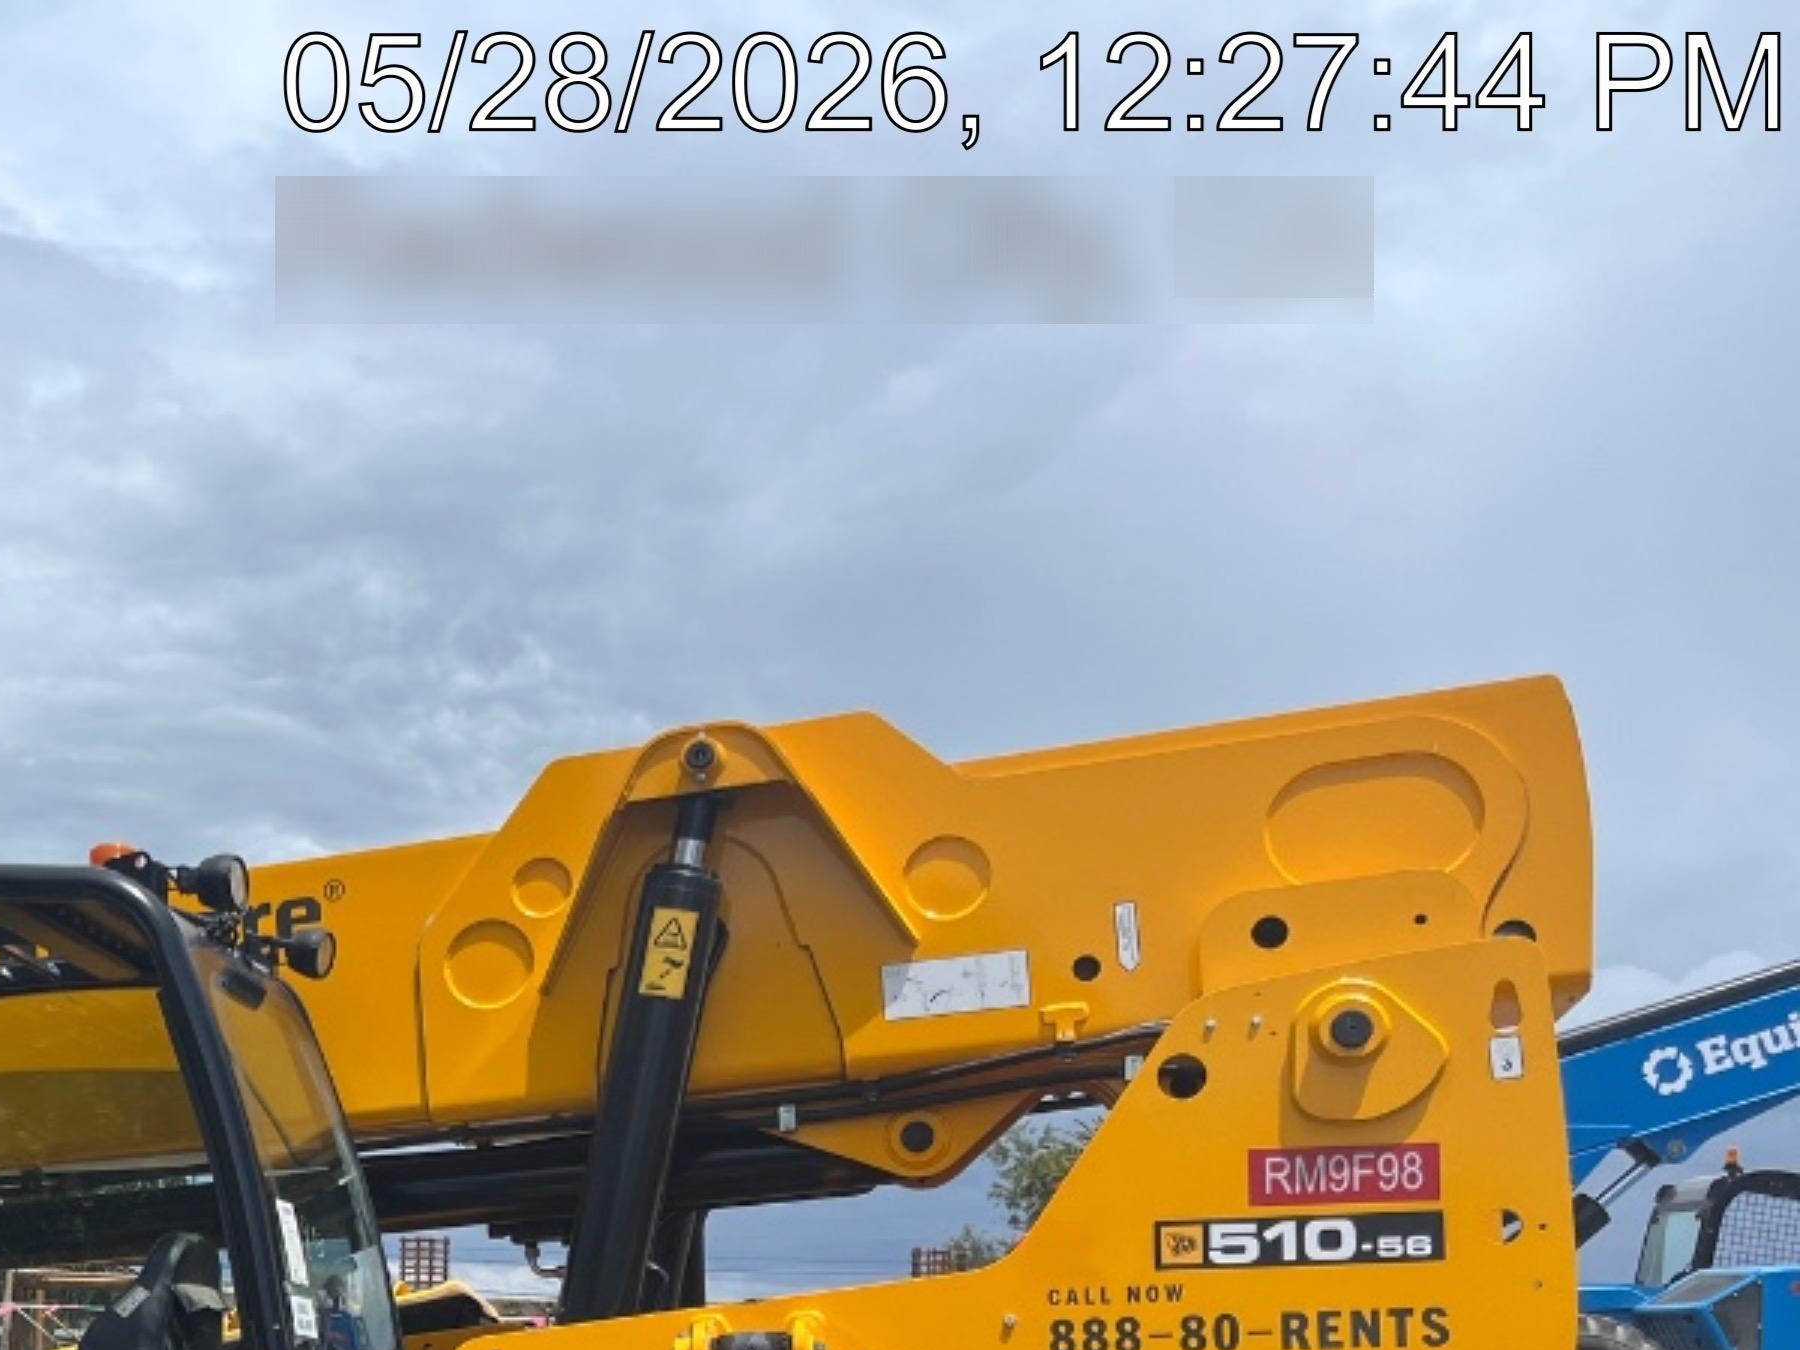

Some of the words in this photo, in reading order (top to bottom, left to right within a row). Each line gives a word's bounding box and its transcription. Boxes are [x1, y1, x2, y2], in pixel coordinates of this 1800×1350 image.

[1263, 1151, 1424, 1195] RM9F98
[1046, 1287, 1113, 1307] CALL
[1126, 1283, 1184, 1304] NOW
